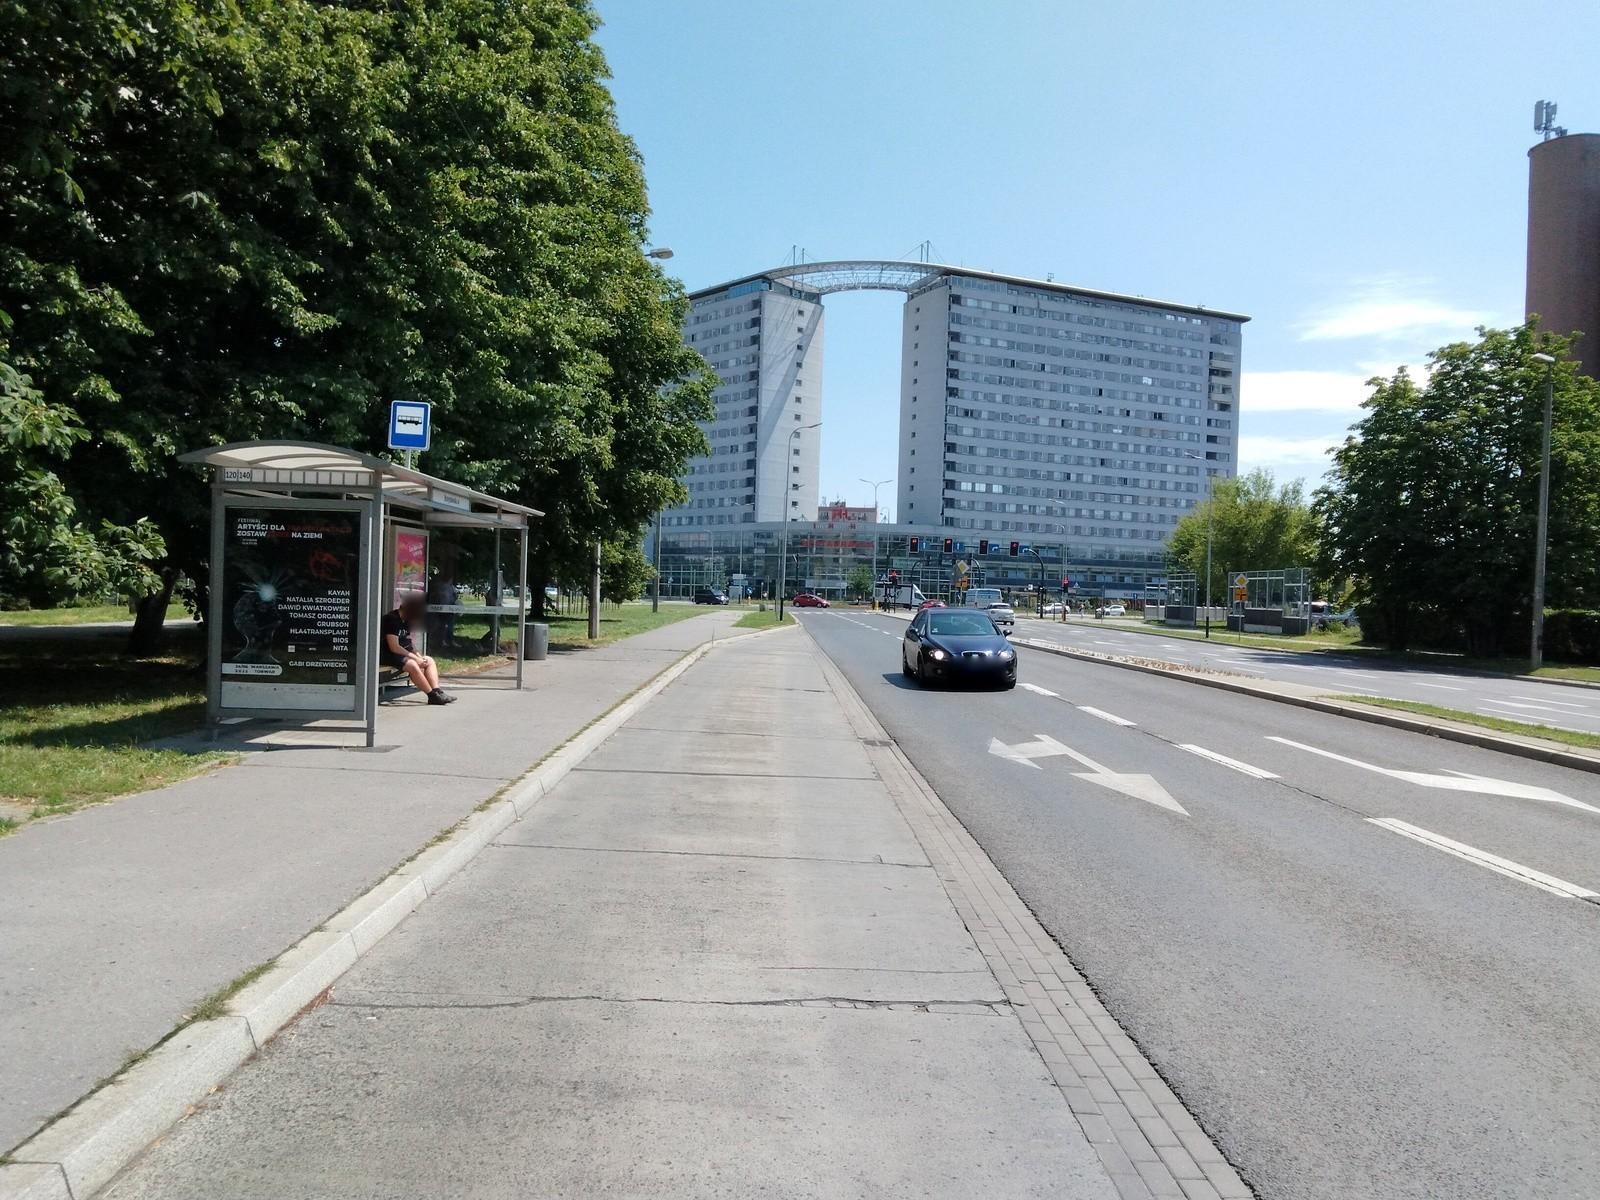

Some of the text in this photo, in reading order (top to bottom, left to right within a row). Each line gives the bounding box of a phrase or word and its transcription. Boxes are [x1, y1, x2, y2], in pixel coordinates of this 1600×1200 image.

[226, 471, 237, 479] 120
[237, 523, 269, 531] ARTYŚCI
[289, 628, 349, 636] HLA4TRANSPLANT
